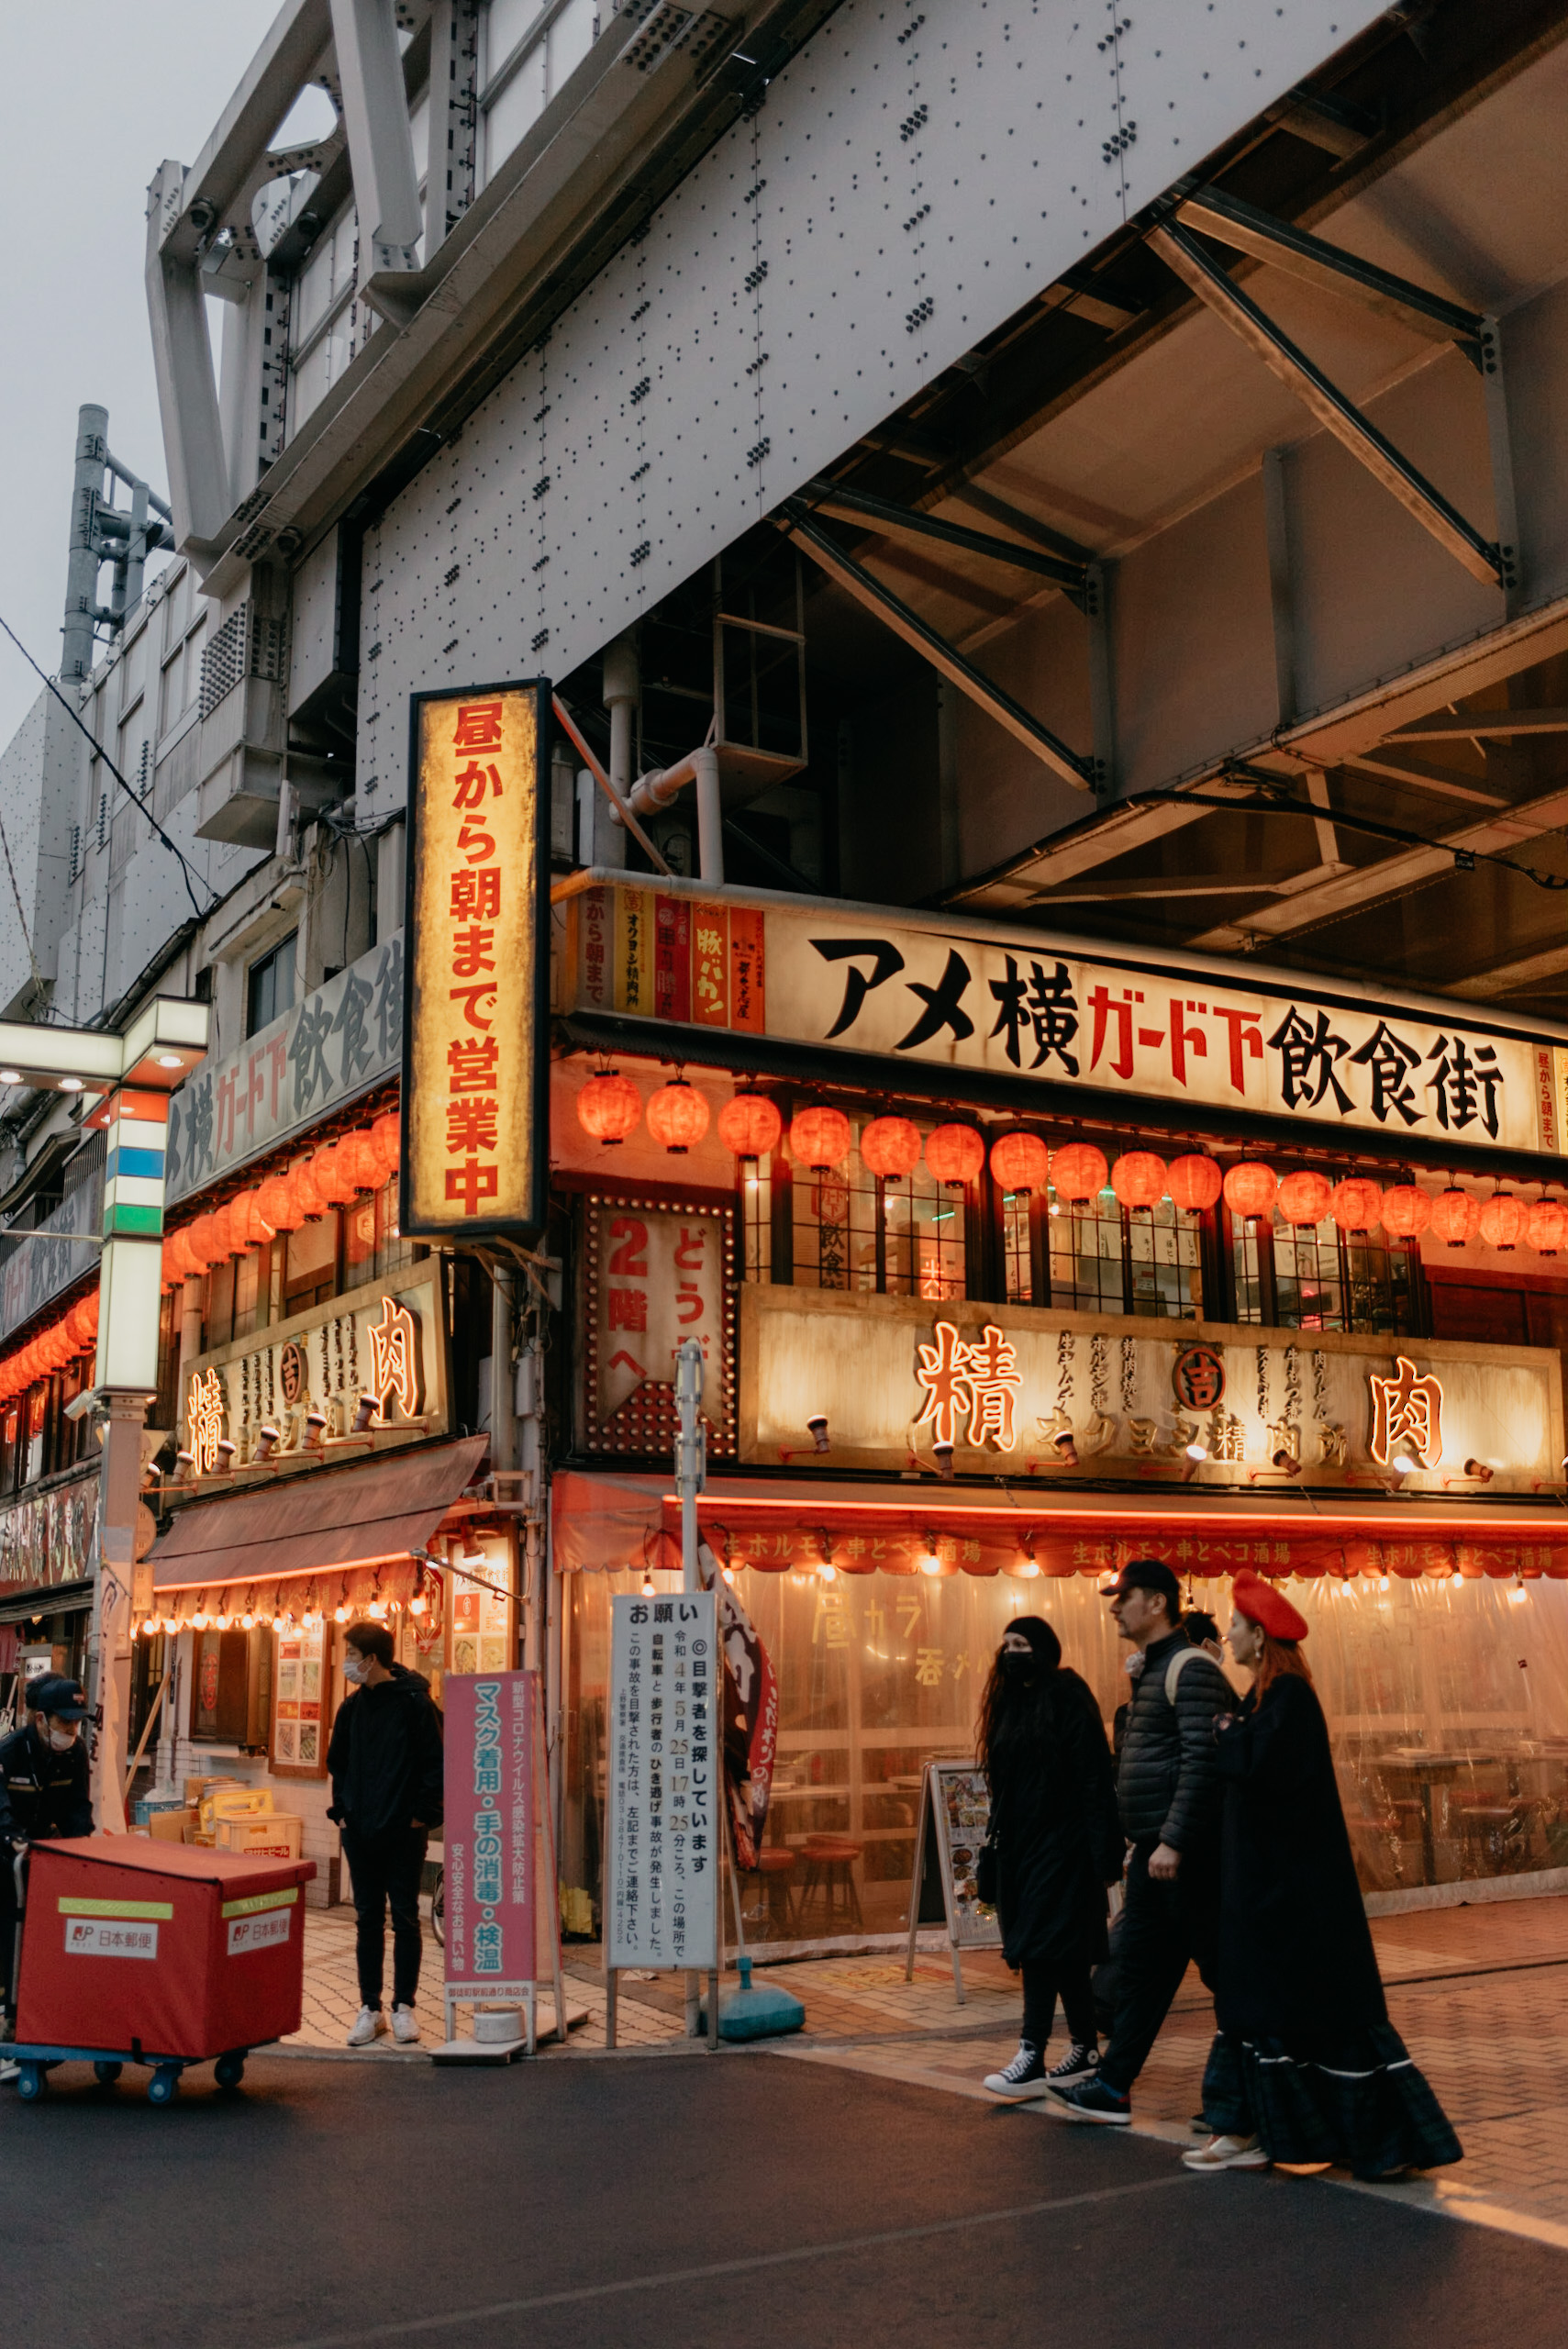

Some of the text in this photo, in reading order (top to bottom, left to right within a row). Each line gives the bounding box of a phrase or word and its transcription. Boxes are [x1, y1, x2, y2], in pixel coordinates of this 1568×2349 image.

[444, 701, 504, 1216] 昼から朝まで営業中
[627, 914, 639, 1007] オクヨシ精肉所
[807, 937, 1503, 1141] アメ横ガード下飲食街
[1538, 1052, 1553, 1148] 昼から朝まで
[608, 1216, 649, 1378] 2階へ
[367, 1296, 415, 1421] 肉
[917, 1321, 1024, 1453] 精
[1091, 1334, 1107, 1410] ホルモン串
[1121, 1337, 1138, 1412] 精肉焼き
[1181, 1352, 1219, 1407] 吉
[1285, 1346, 1300, 1419] 牛もつ煮
[1314, 1350, 1328, 1419] 肉うどん
[1370, 1354, 1444, 1469] 肉
[629, 1603, 698, 1624] お願い
[475, 1683, 502, 1972] マスク着用・手の消毒・検温
[511, 1681, 526, 1904] 新型コロナウイルス感染拡大防止策
[99, 1931, 151, 1949] 日本郵便
[252, 1919, 287, 1941] 日本郵便
[451, 1843, 464, 1971] 安心安全なお買い物
